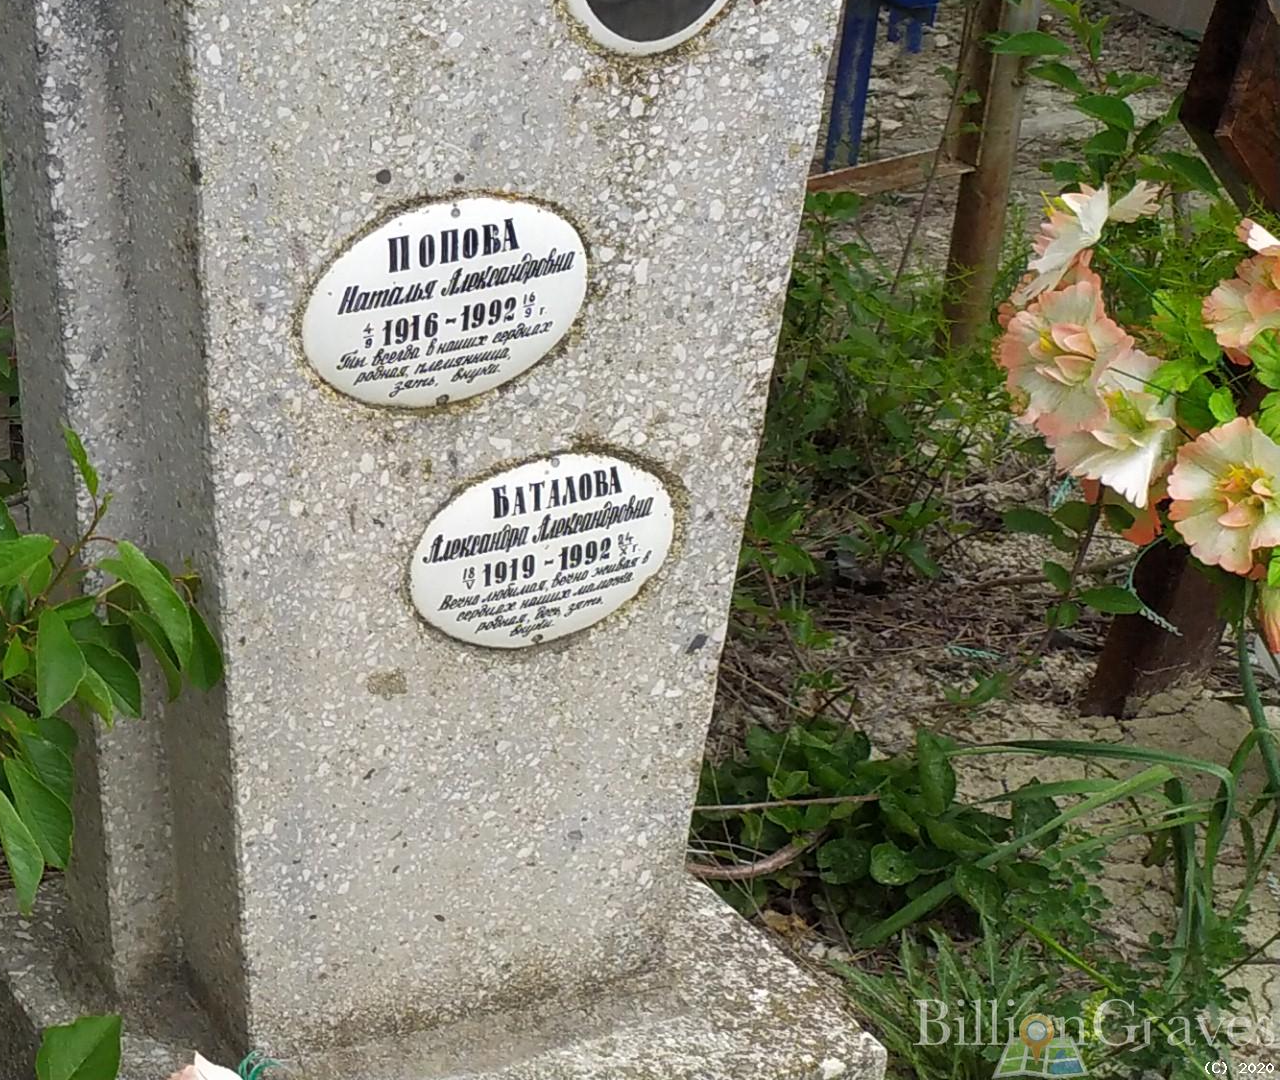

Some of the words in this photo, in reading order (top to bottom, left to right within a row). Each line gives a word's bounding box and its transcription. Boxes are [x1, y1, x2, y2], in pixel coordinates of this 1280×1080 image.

[387, 218, 520, 273] ПОПОВА
[338, 280, 438, 315] Наталья
[441, 247, 575, 299] Александровна
[336, 350, 367, 370] Ты
[371, 344, 420, 367] всегда
[492, 466, 622, 519] БАТАЛОВА
[423, 523, 530, 564] Александра
[533, 495, 655, 544] Александровна
